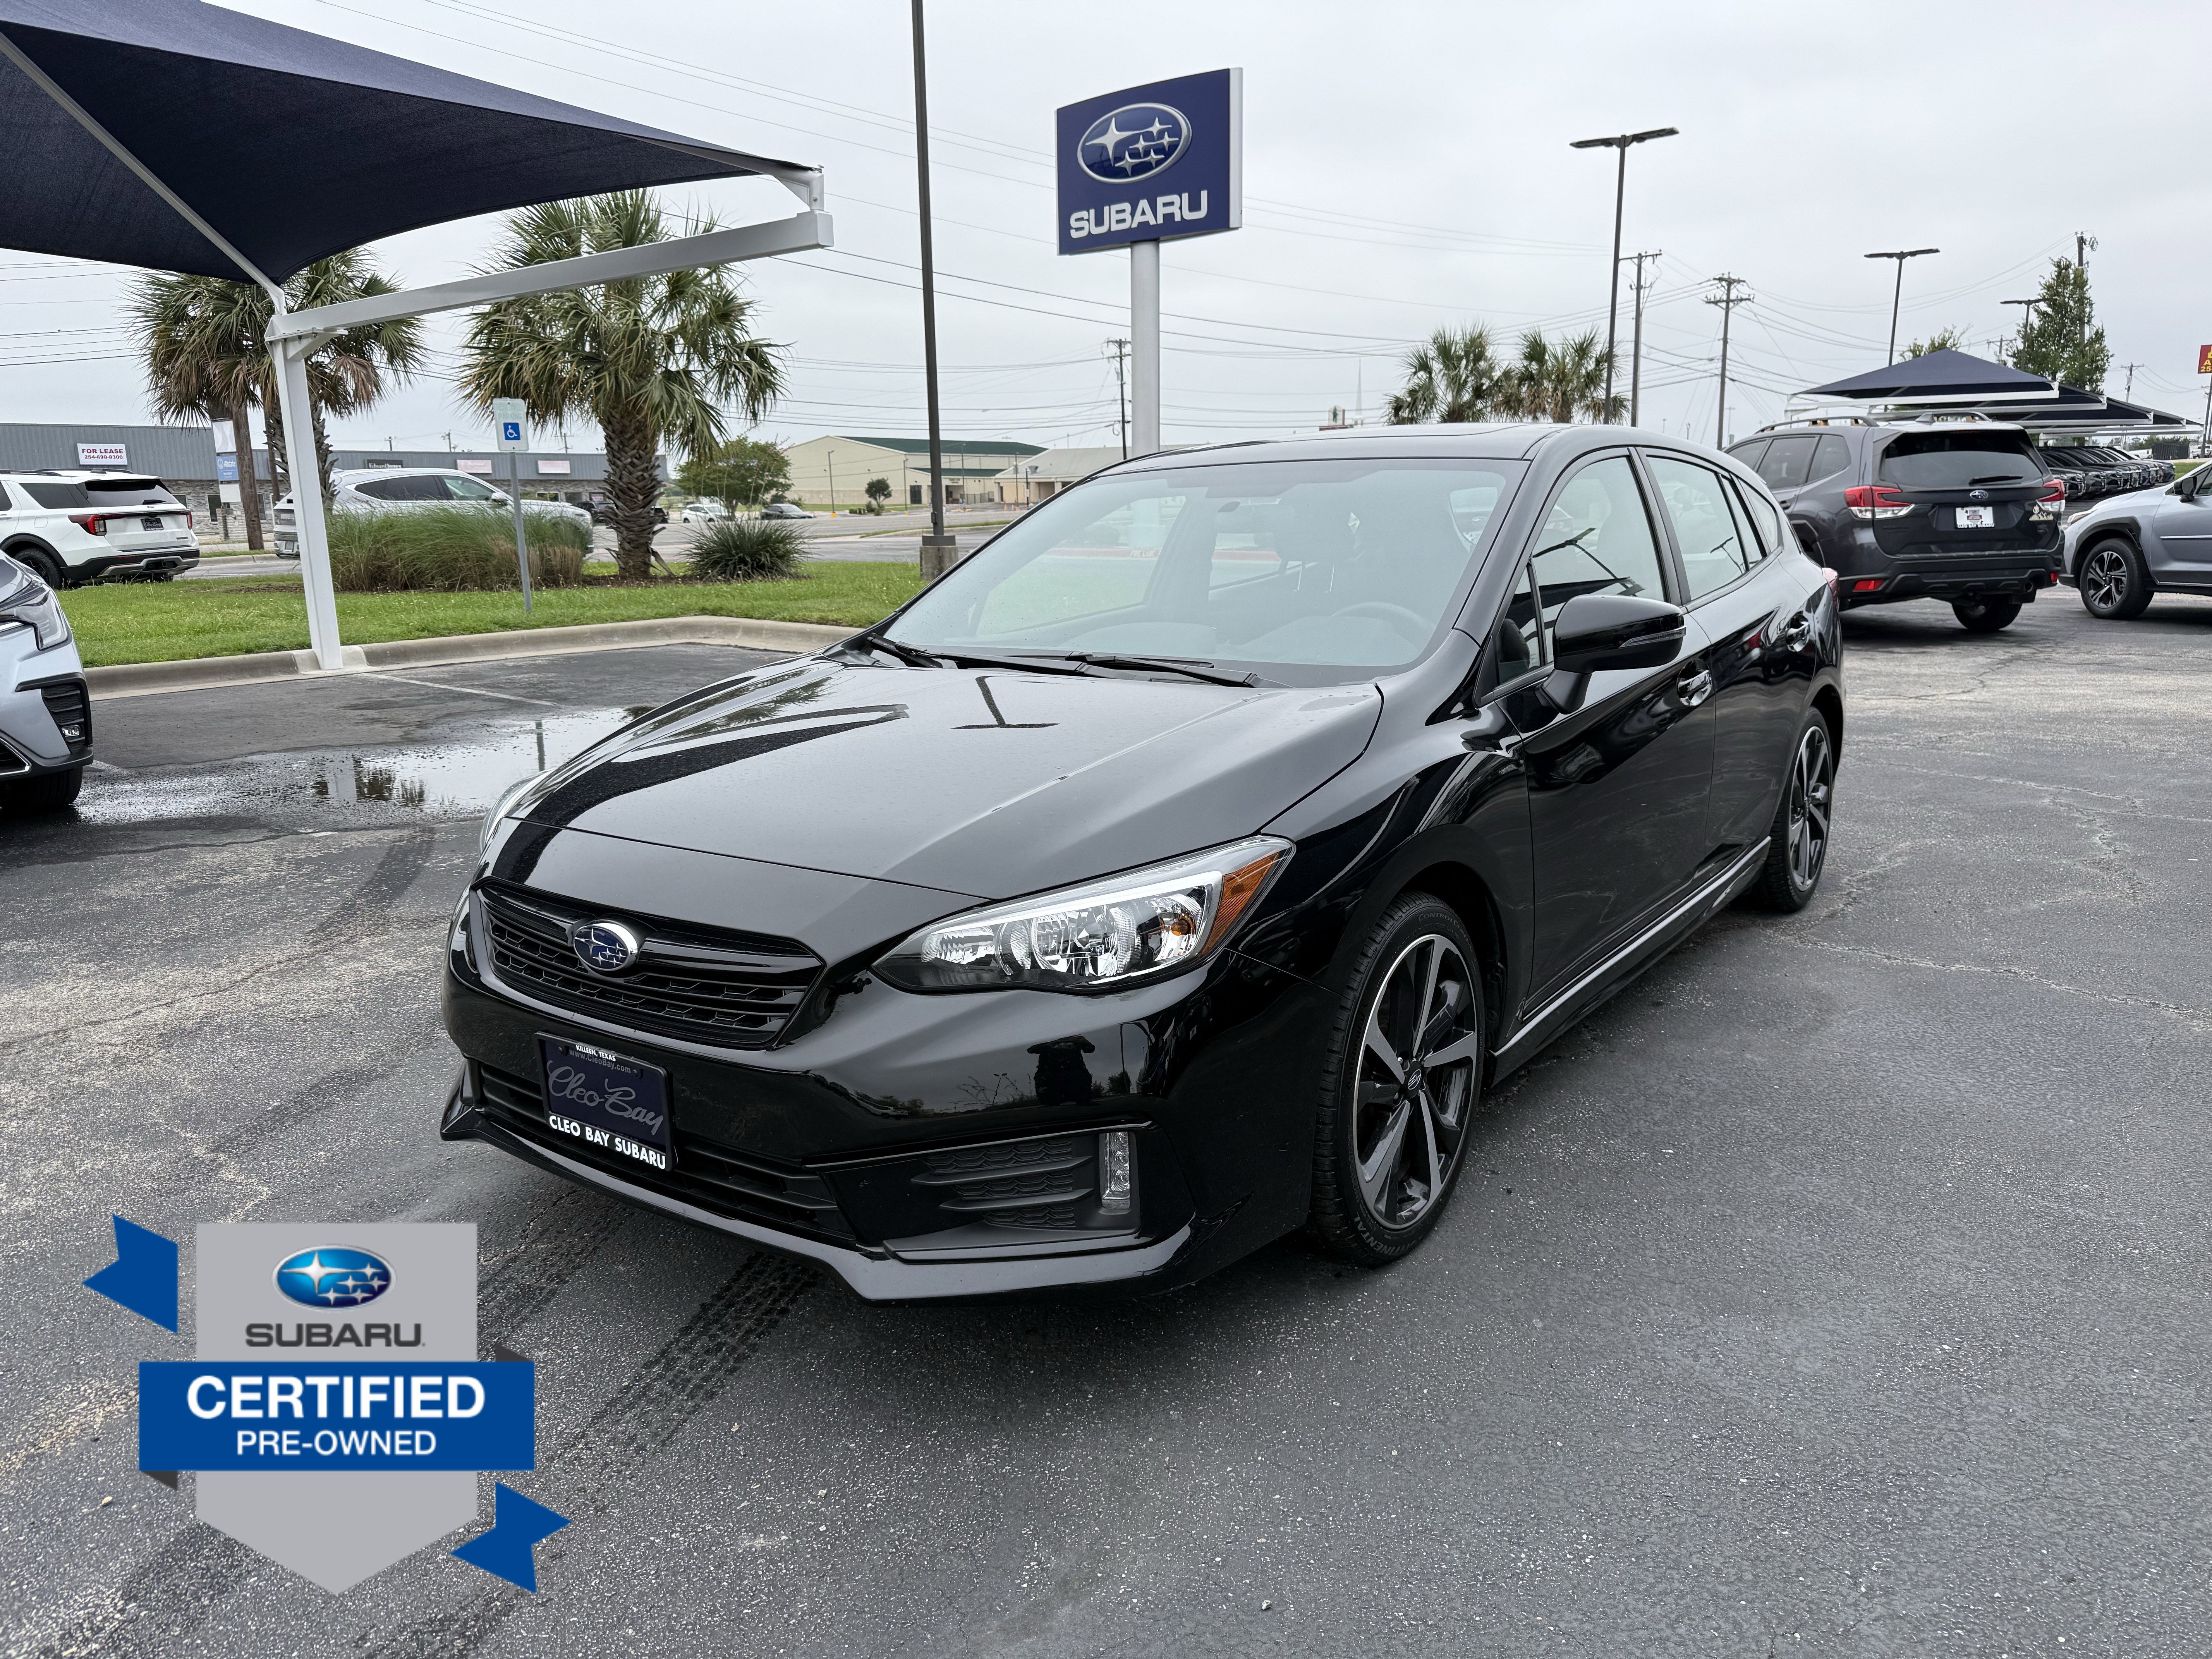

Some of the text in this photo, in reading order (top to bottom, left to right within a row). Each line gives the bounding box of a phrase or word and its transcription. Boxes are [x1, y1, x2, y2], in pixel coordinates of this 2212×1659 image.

[1070, 189, 1208, 239] SUBARU
[569, 1049, 631, 1073] www.CleoBay.com
[576, 1044, 616, 1062] KILLEEN, TEXAS
[546, 1060, 664, 1135] Cleo Bay
[549, 1115, 581, 1137] CLEO
[585, 1126, 610, 1147] BAY
[615, 1137, 666, 1170] SUBARU
